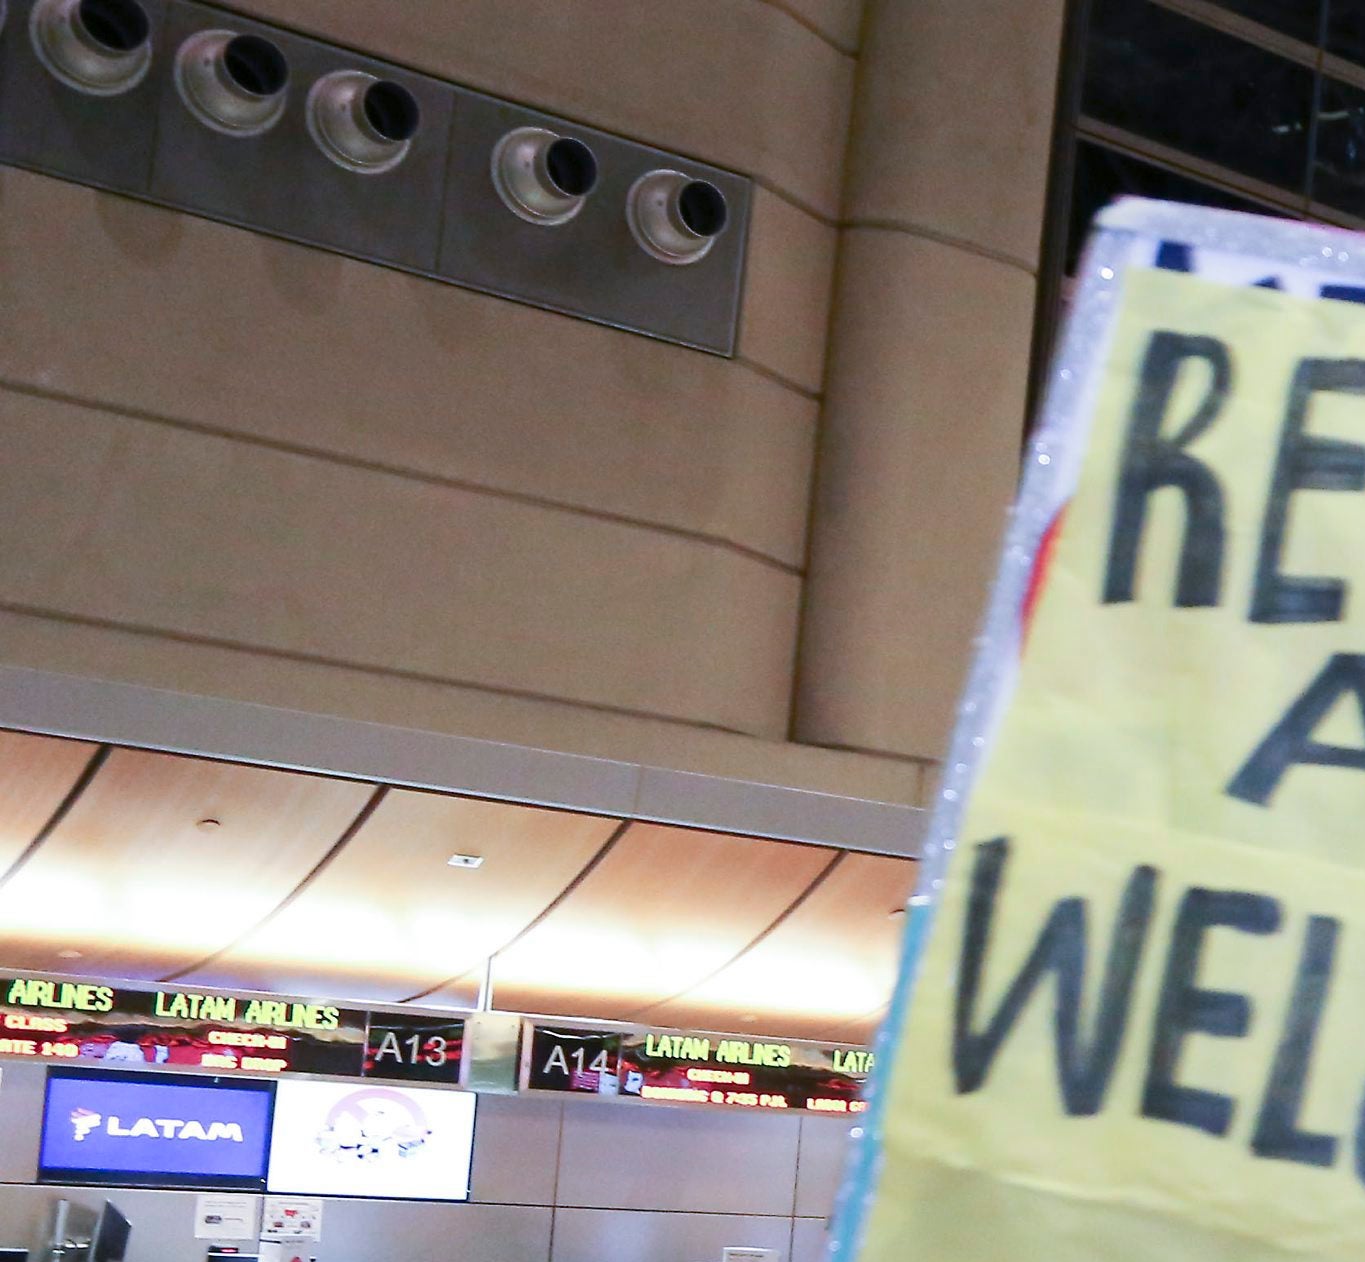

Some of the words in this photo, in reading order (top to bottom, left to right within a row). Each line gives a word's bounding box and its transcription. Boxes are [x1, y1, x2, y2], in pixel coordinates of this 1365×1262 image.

[8, 978, 114, 1012] AIRLINES
[154, 990, 237, 1022] LATAM
[243, 999, 341, 1030] AIRLINES
[374, 1030, 448, 1068] A13
[541, 1044, 609, 1078] A14
[644, 1033, 712, 1062] LATAM
[715, 1039, 793, 1069] AIRLINES
[106, 1116, 244, 1142] LATAM
